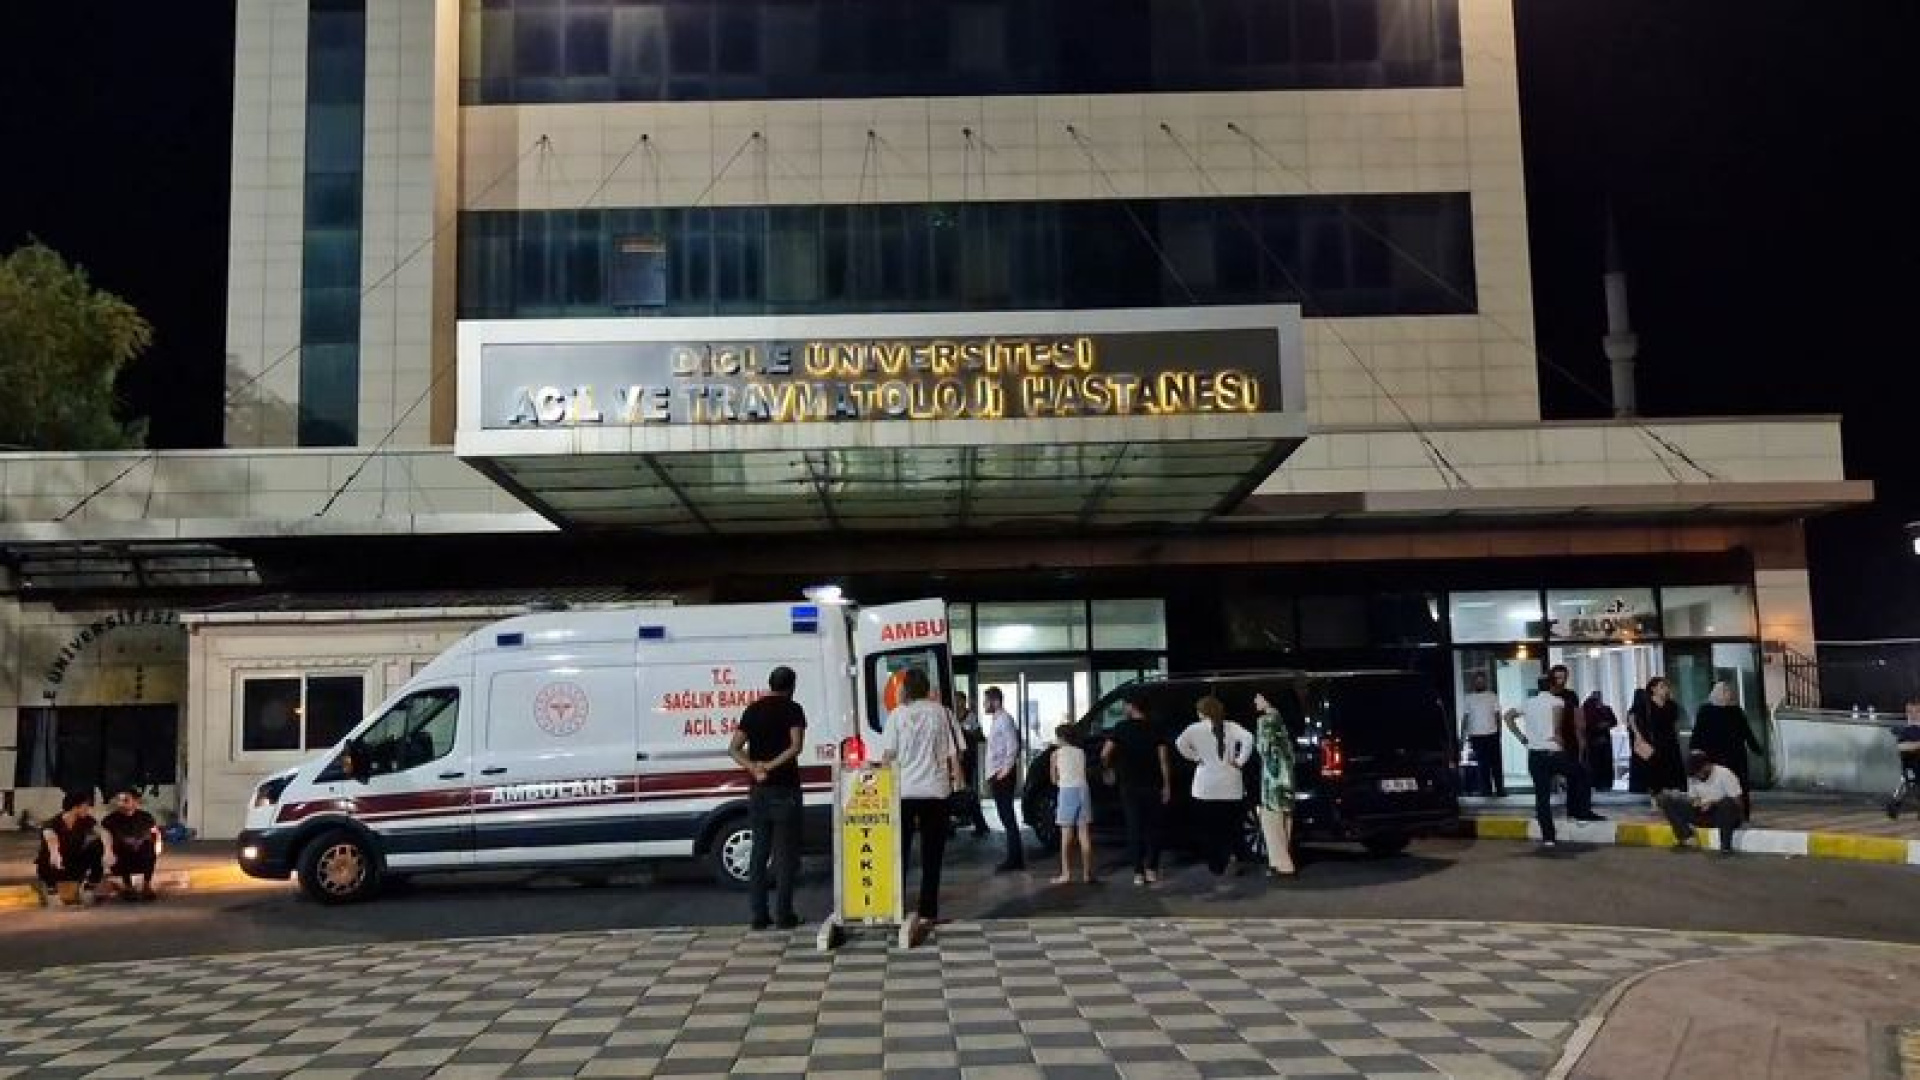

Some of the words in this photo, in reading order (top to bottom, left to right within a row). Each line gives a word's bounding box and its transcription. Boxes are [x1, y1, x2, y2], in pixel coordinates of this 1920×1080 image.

[614, 382, 672, 424] VE
[881, 618, 946, 642] AMBU
[492, 776, 616, 805] AMBULANS
